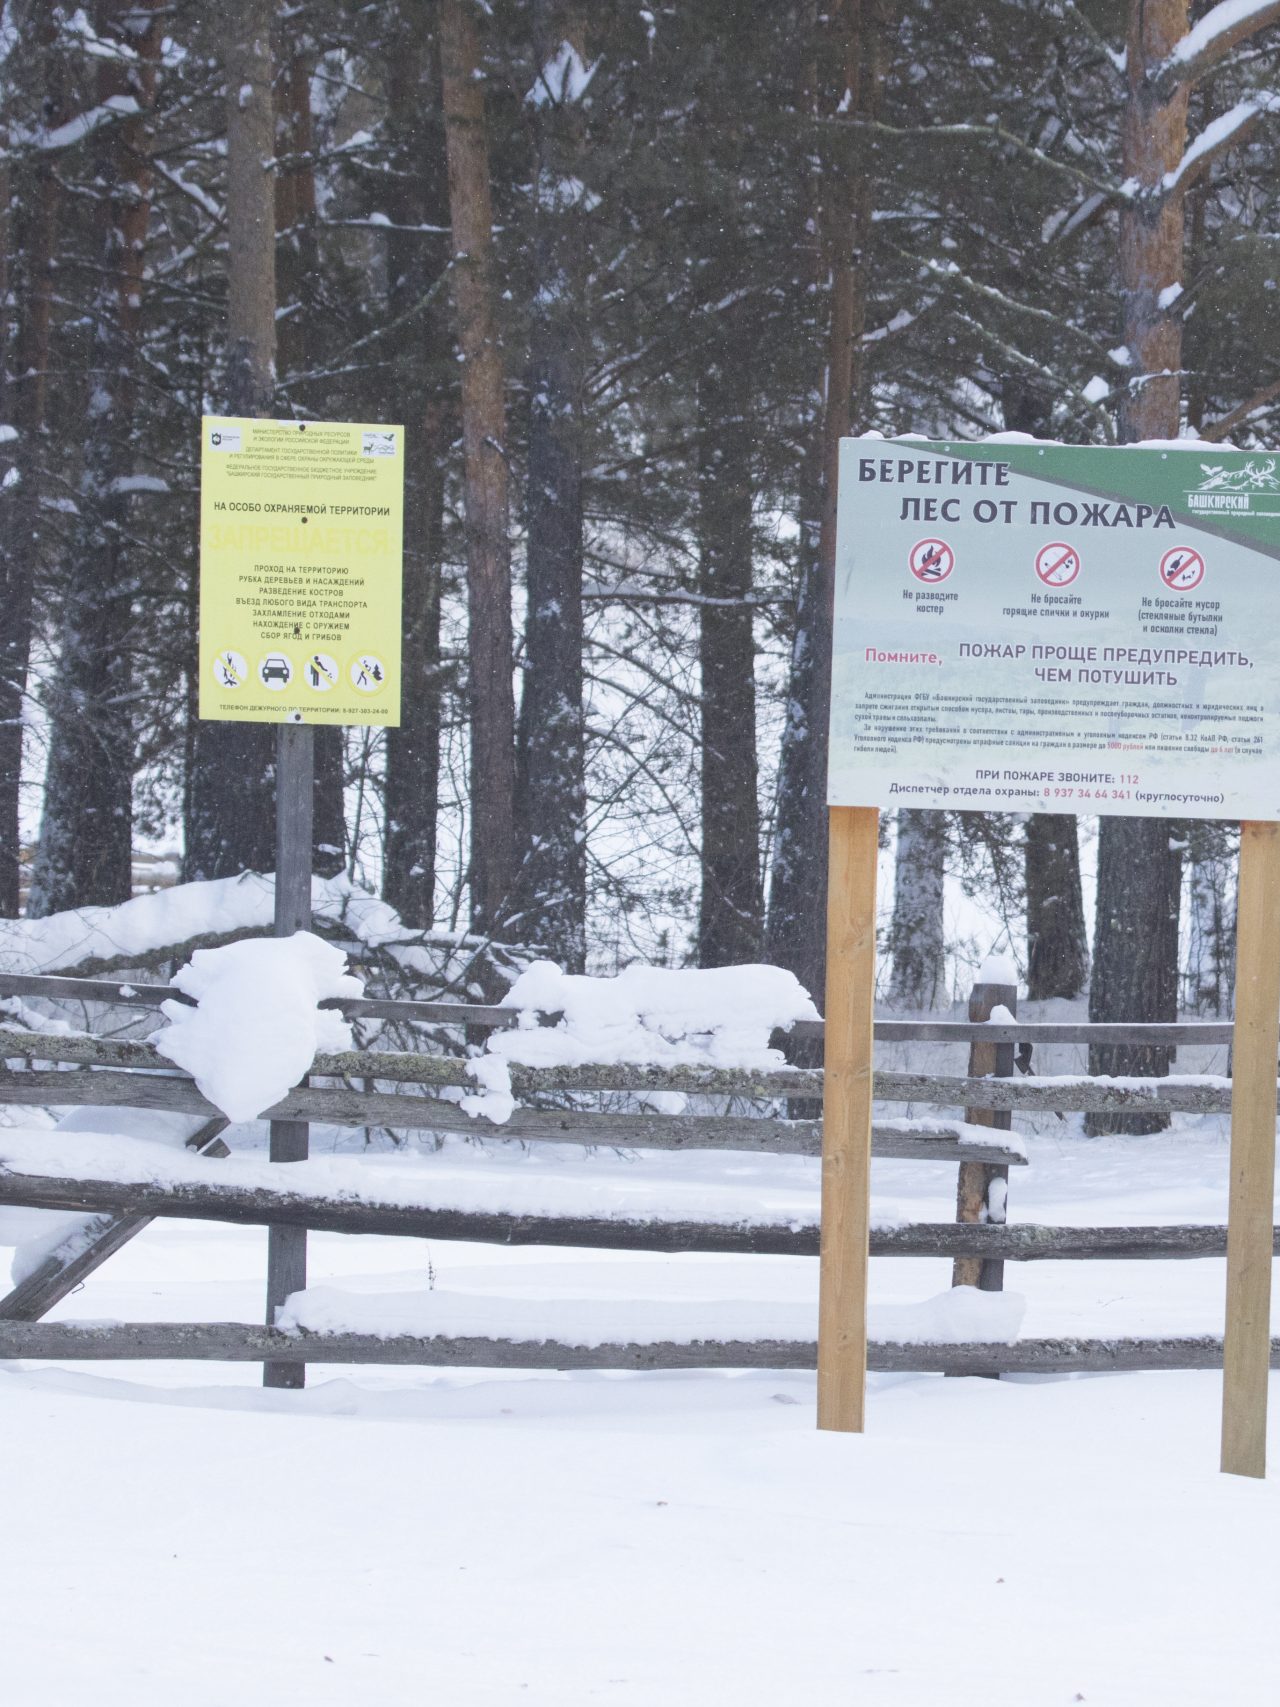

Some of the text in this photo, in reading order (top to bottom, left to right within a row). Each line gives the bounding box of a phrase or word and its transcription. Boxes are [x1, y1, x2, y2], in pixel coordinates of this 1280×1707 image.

[858, 458, 1010, 487] БЕРЕГИТЕ
[1188, 494, 1249, 510] БАШКИРСКИЙ
[214, 502, 390, 516] НА ОСОБО ОХРАНЯЕМОЙ ТЕРРИТОРИИ
[900, 497, 1177, 529] ЛЕС ОТ ПОЖАРА
[254, 565, 349, 574] ПРОХОД НА ТЕРРИТОРИЮ
[264, 576, 302, 584] ДЕРЕВЬЕВ
[313, 577, 364, 586] НАСАЖДЕНИЙ
[259, 588, 306, 596] РАЗВЕДЕНИЕ
[903, 589, 958, 603] Не разводите
[236, 598, 367, 608] ВЪЕЗД ЛЮБОГО ВИДА ТРАНСПОРТА
[1031, 594, 1082, 606] Не бросайте
[1142, 597, 1220, 610] Не бросайте мусор
[253, 610, 350, 619] ЗАХЛАМЛЕНИЕ ОТХОДАМИ
[916, 604, 944, 616] костер
[1003, 607, 1109, 620] горящие спички и окурки
[1188, 611, 1222, 622] бутылки
[253, 621, 302, 629] НАХОЖДЕНИЕ
[1151, 625, 1184, 634] осколки
[1187, 625, 1217, 636] стекла)
[313, 633, 341, 641] ГРИБОВ
[865, 649, 943, 667] Помните,
[959, 643, 1254, 668] ПОЖАР ПРОЩЕ ПРЕДУПРЕДИТЬ,
[1034, 667, 1178, 686] ЧЕМ ПОТУШИТЬ
[975, 770, 1139, 785] ПРИ ПОЖАРЕ ЗВОНИТЕ: 112
[890, 783, 1224, 805] Диспетчер отдела охраны: 8 937 34 64 341 (круглосуточно)
